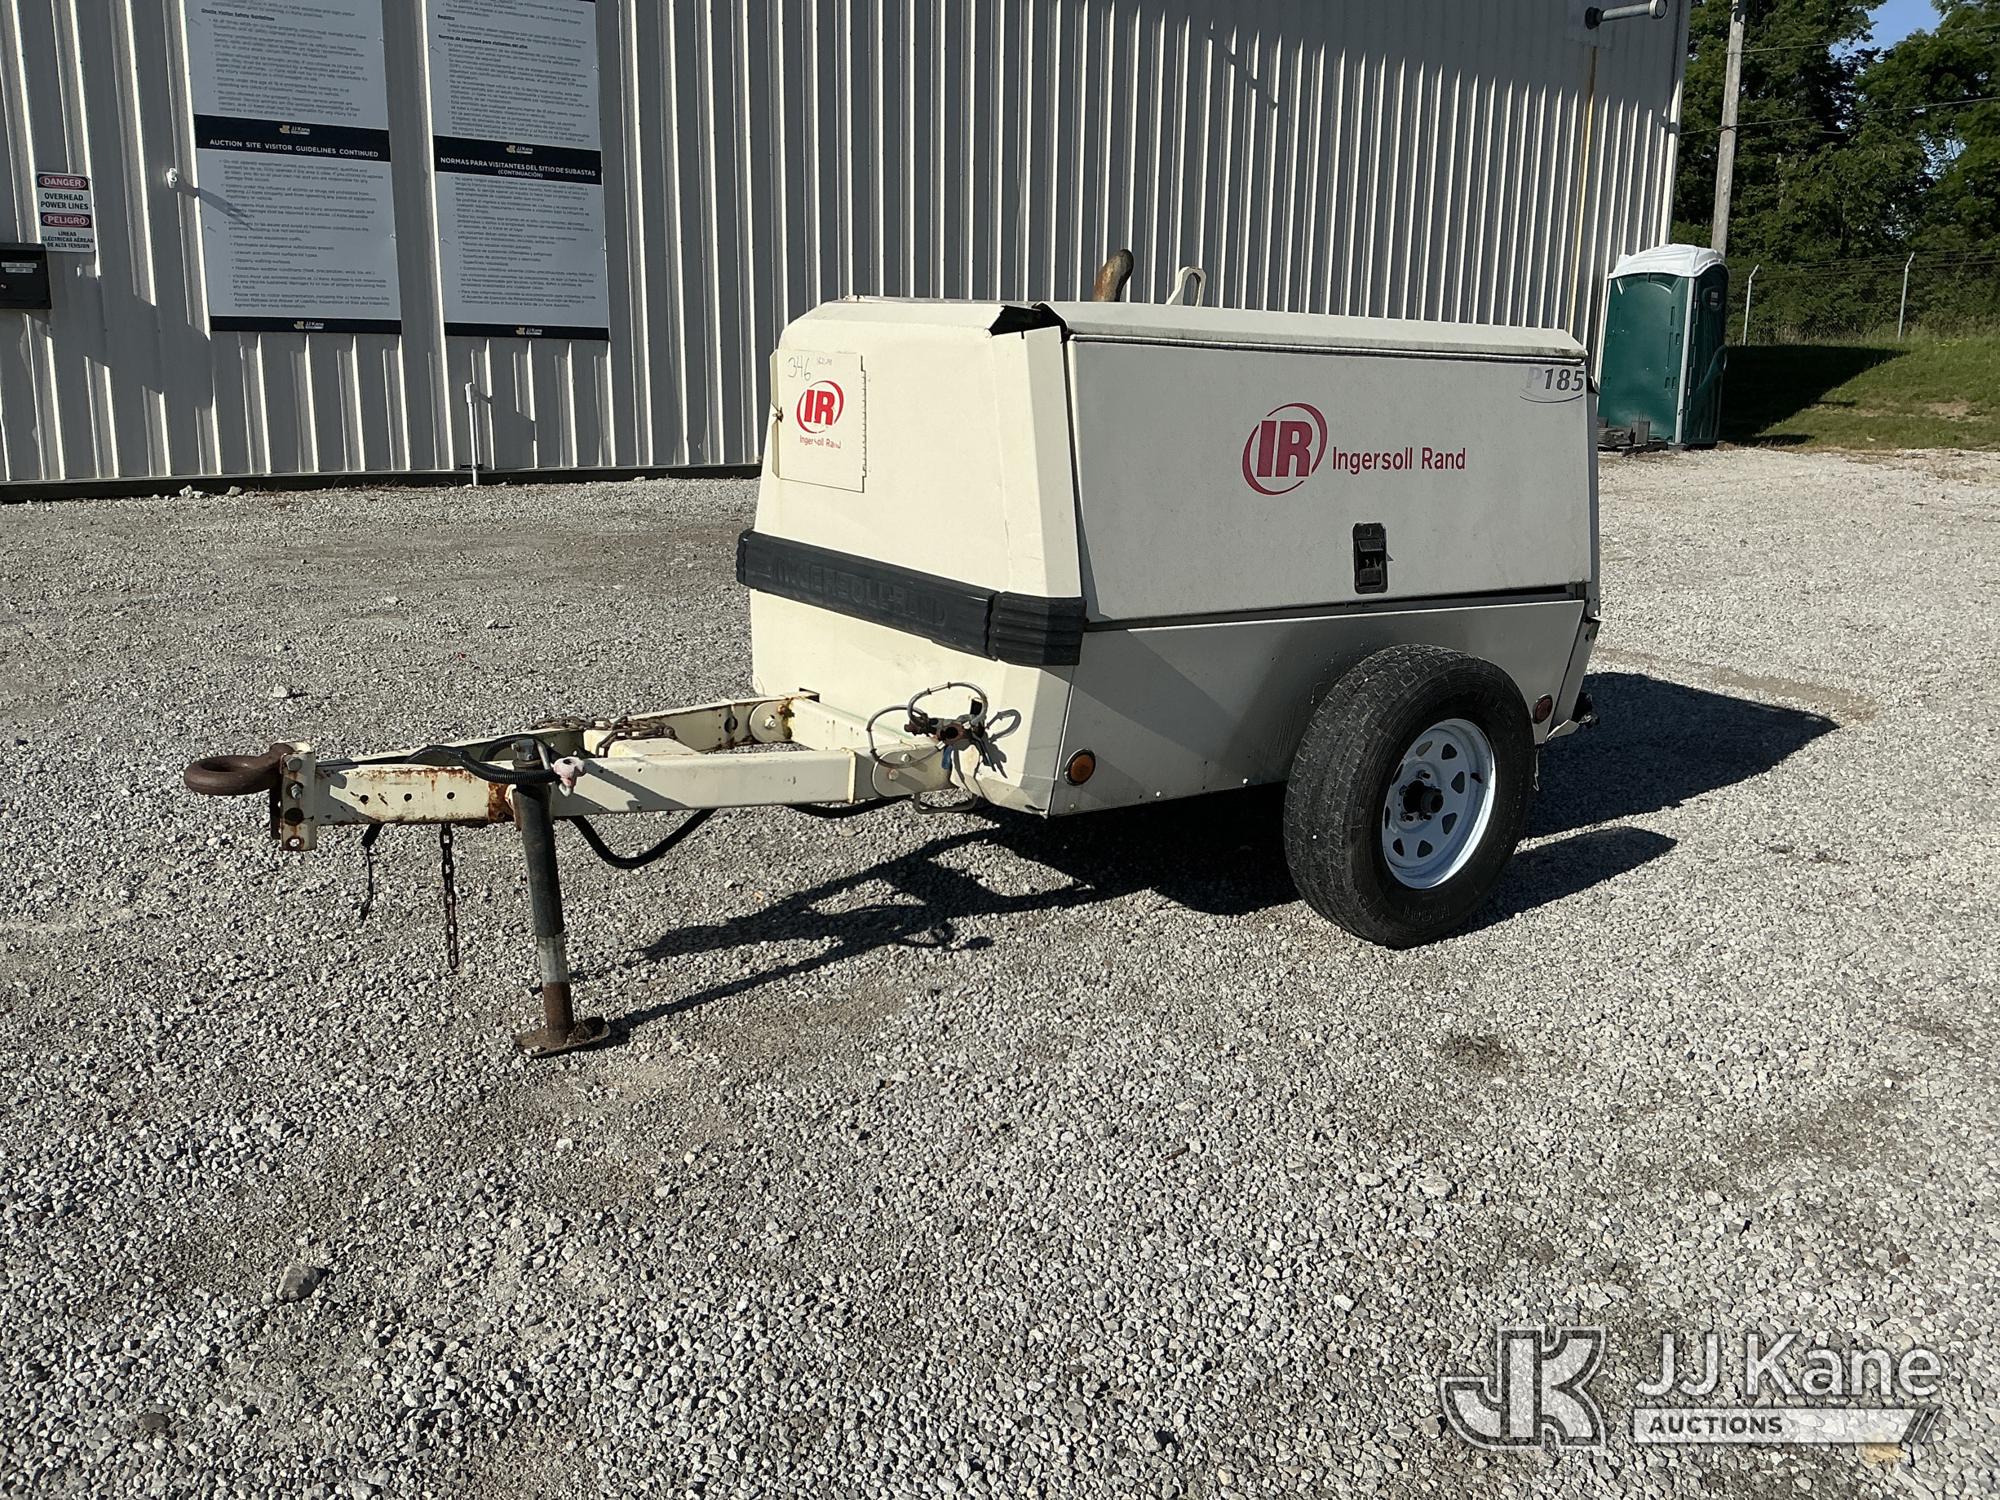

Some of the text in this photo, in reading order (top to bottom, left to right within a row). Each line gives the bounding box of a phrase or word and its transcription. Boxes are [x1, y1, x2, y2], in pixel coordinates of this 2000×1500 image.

[209, 139, 378, 158] AUCTION SITE VISITOR GUIDELINES CONTINUED
[440, 157, 469, 165] NORMAS
[488, 161, 525, 170] VISITANTES
[564, 167, 596, 177] SUBASTAS
[44, 178, 82, 187] DANGER
[40, 201, 89, 210] POWER LINES
[44, 192, 84, 201] OVERHEAD
[47, 215, 86, 225] PELIGRO
[787, 355, 811, 381] 346
[1526, 366, 1585, 392] P185
[803, 389, 836, 426] IR
[799, 435, 842, 449] Ingersoll Rand
[1256, 420, 1313, 478] IR
[1332, 446, 1466, 475] Ingersoll Rand
